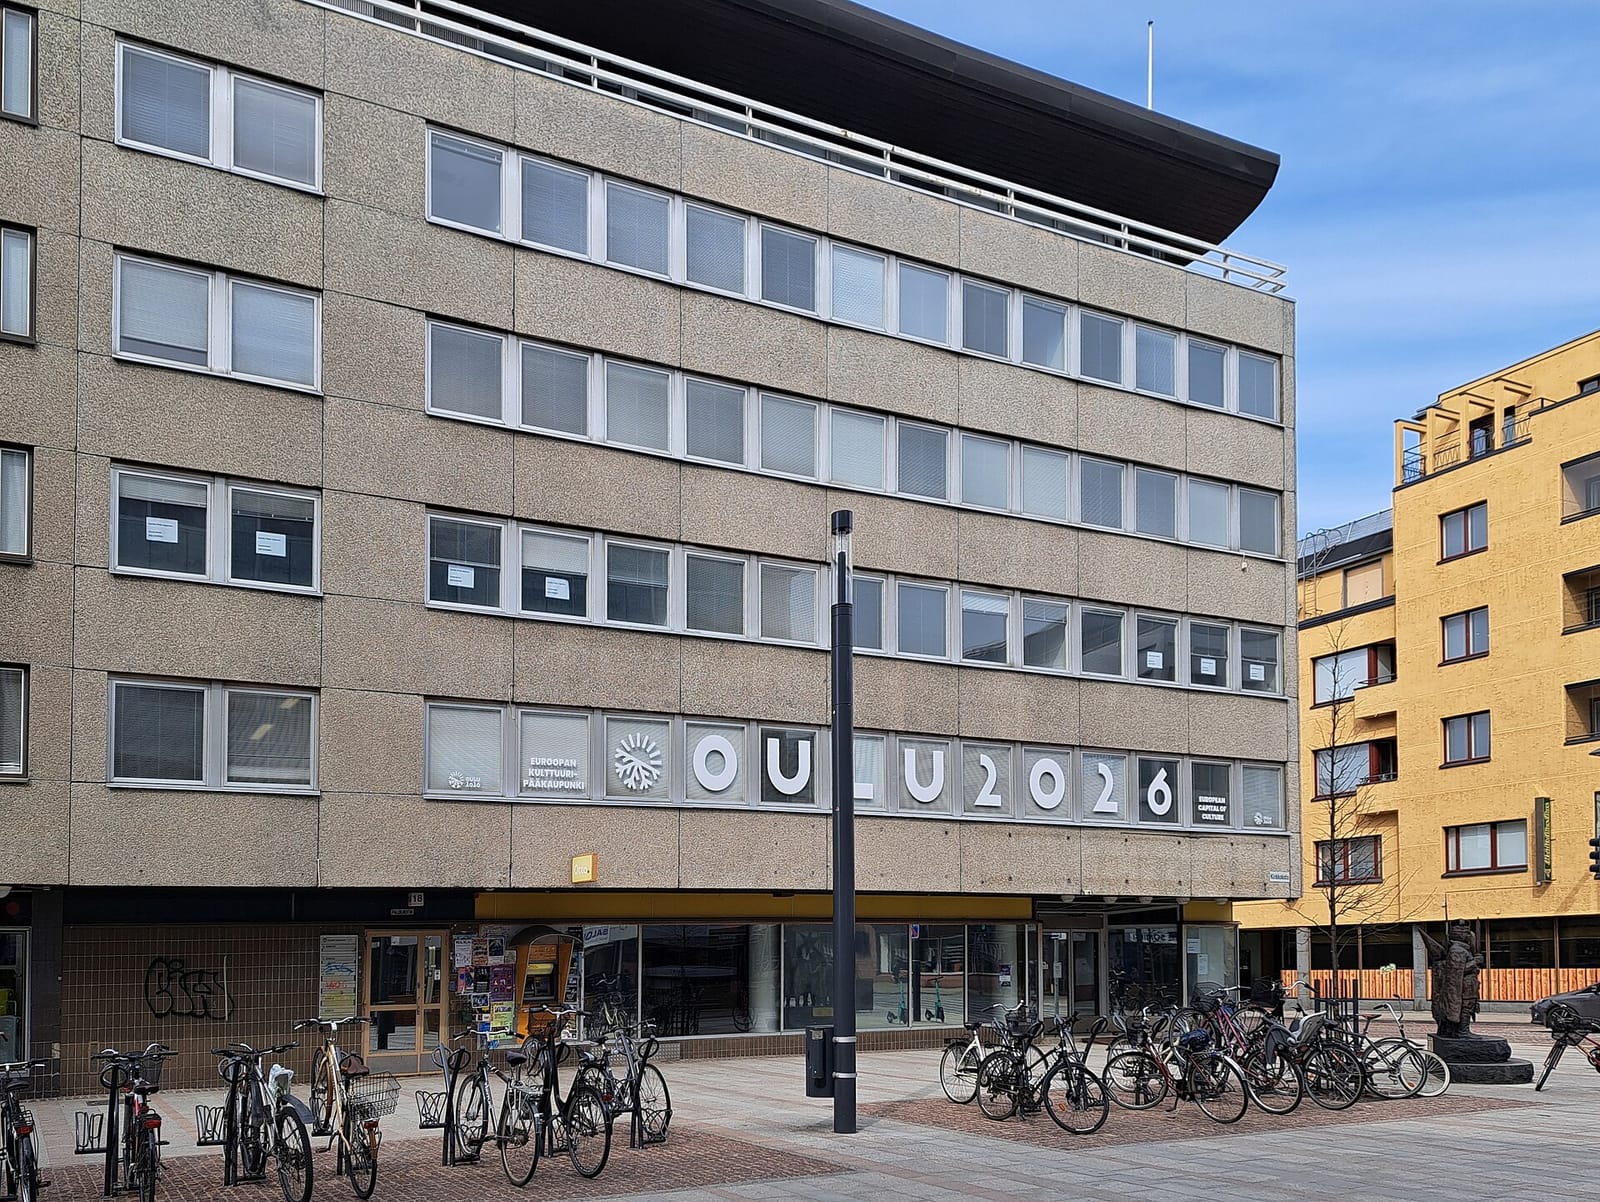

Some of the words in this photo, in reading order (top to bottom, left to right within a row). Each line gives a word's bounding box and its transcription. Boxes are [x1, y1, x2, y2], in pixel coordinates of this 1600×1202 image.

[530, 757, 577, 767] EUROOPAN
[528, 768, 578, 778] KULTTUURI-
[523, 777, 585, 790] PÄÄKAUPUNKI
[974, 754, 1172, 816] 2026
[1198, 796, 1226, 804] EUROPEAN
[1197, 804, 1219, 812] CAPITAL
[1201, 813, 1225, 821] CULTURE
